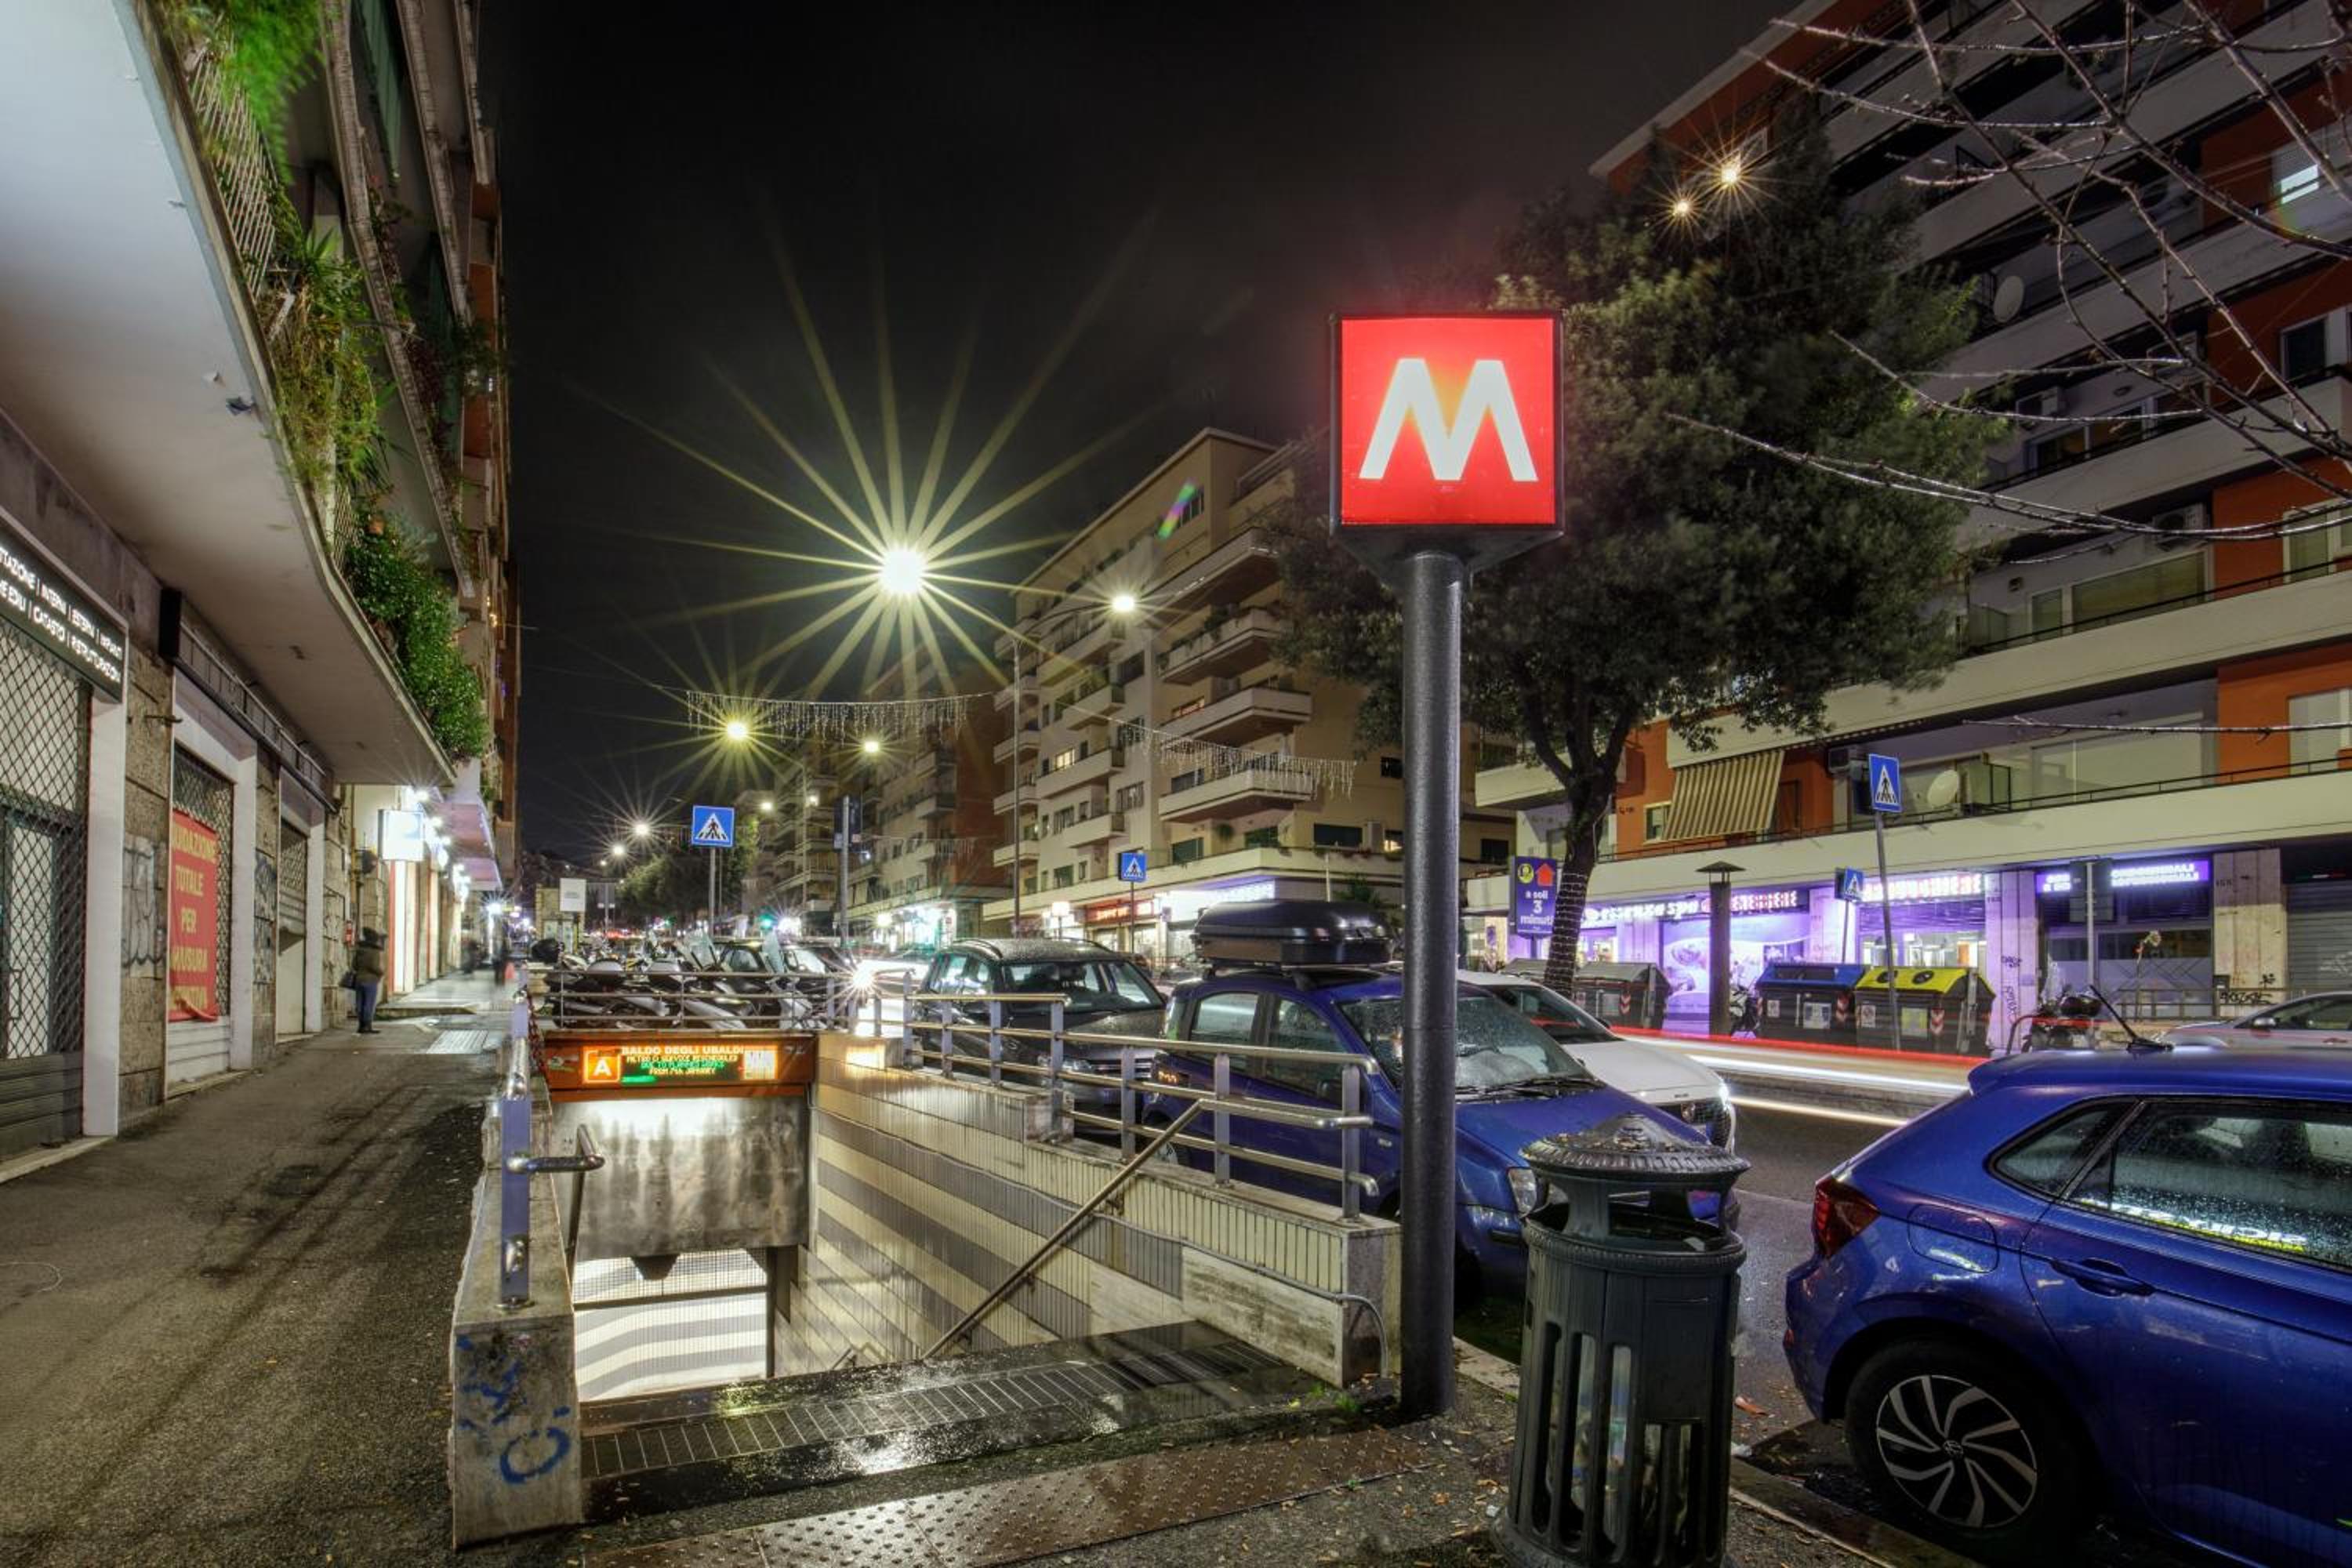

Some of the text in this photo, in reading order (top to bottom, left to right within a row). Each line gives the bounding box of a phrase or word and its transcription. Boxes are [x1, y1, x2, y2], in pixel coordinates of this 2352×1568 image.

[1359, 358, 1539, 483] M
[175, 865, 204, 897] TOTALE
[1534, 900, 1543, 914] 3
[181, 907, 196, 933] PER
[622, 1045, 744, 1055] BALDO DEGLI UBALDI
[593, 1058, 612, 1076] A
